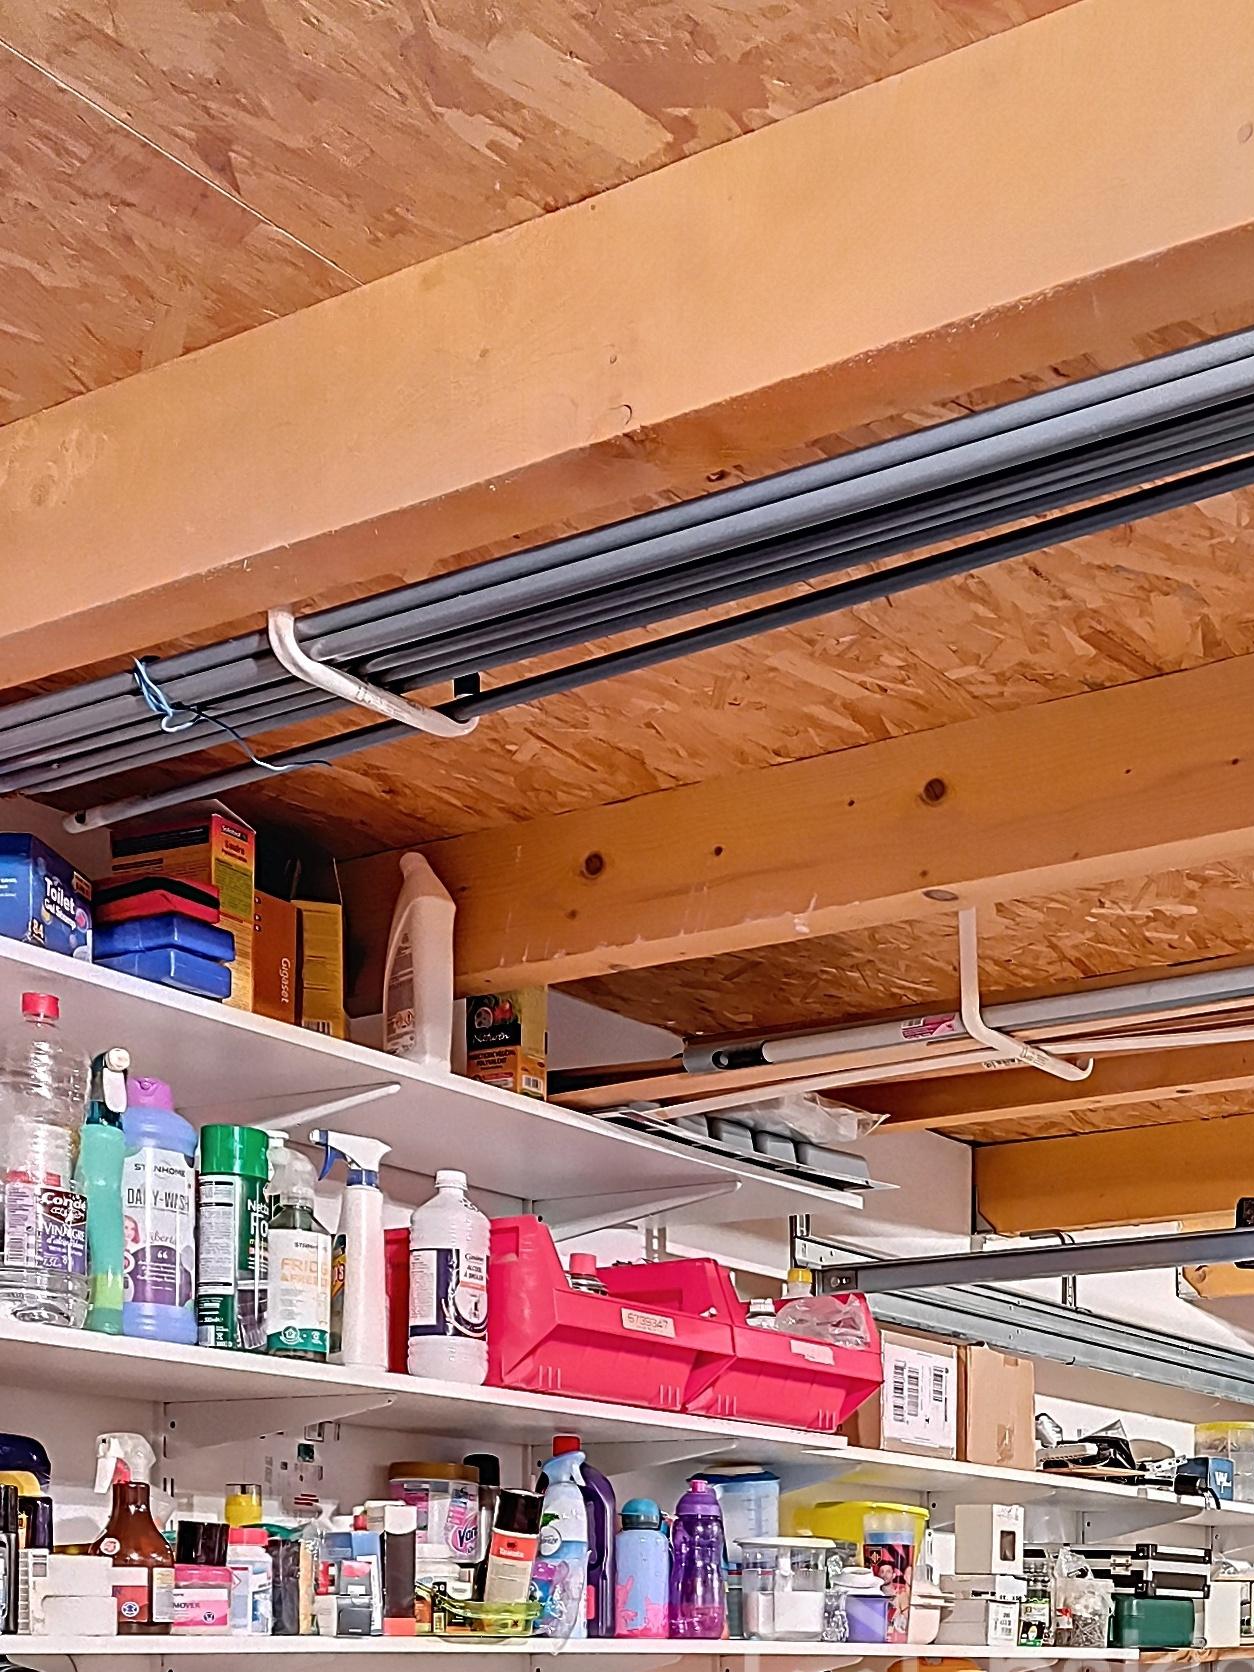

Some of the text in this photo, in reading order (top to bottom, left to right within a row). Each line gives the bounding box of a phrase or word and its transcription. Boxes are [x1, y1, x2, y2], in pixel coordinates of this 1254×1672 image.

[44, 876, 76, 915] Toilet
[278, 957, 291, 1004] Gigaset
[134, 1163, 186, 1178] STNHOME
[173, 1601, 201, 1610] MOVER
